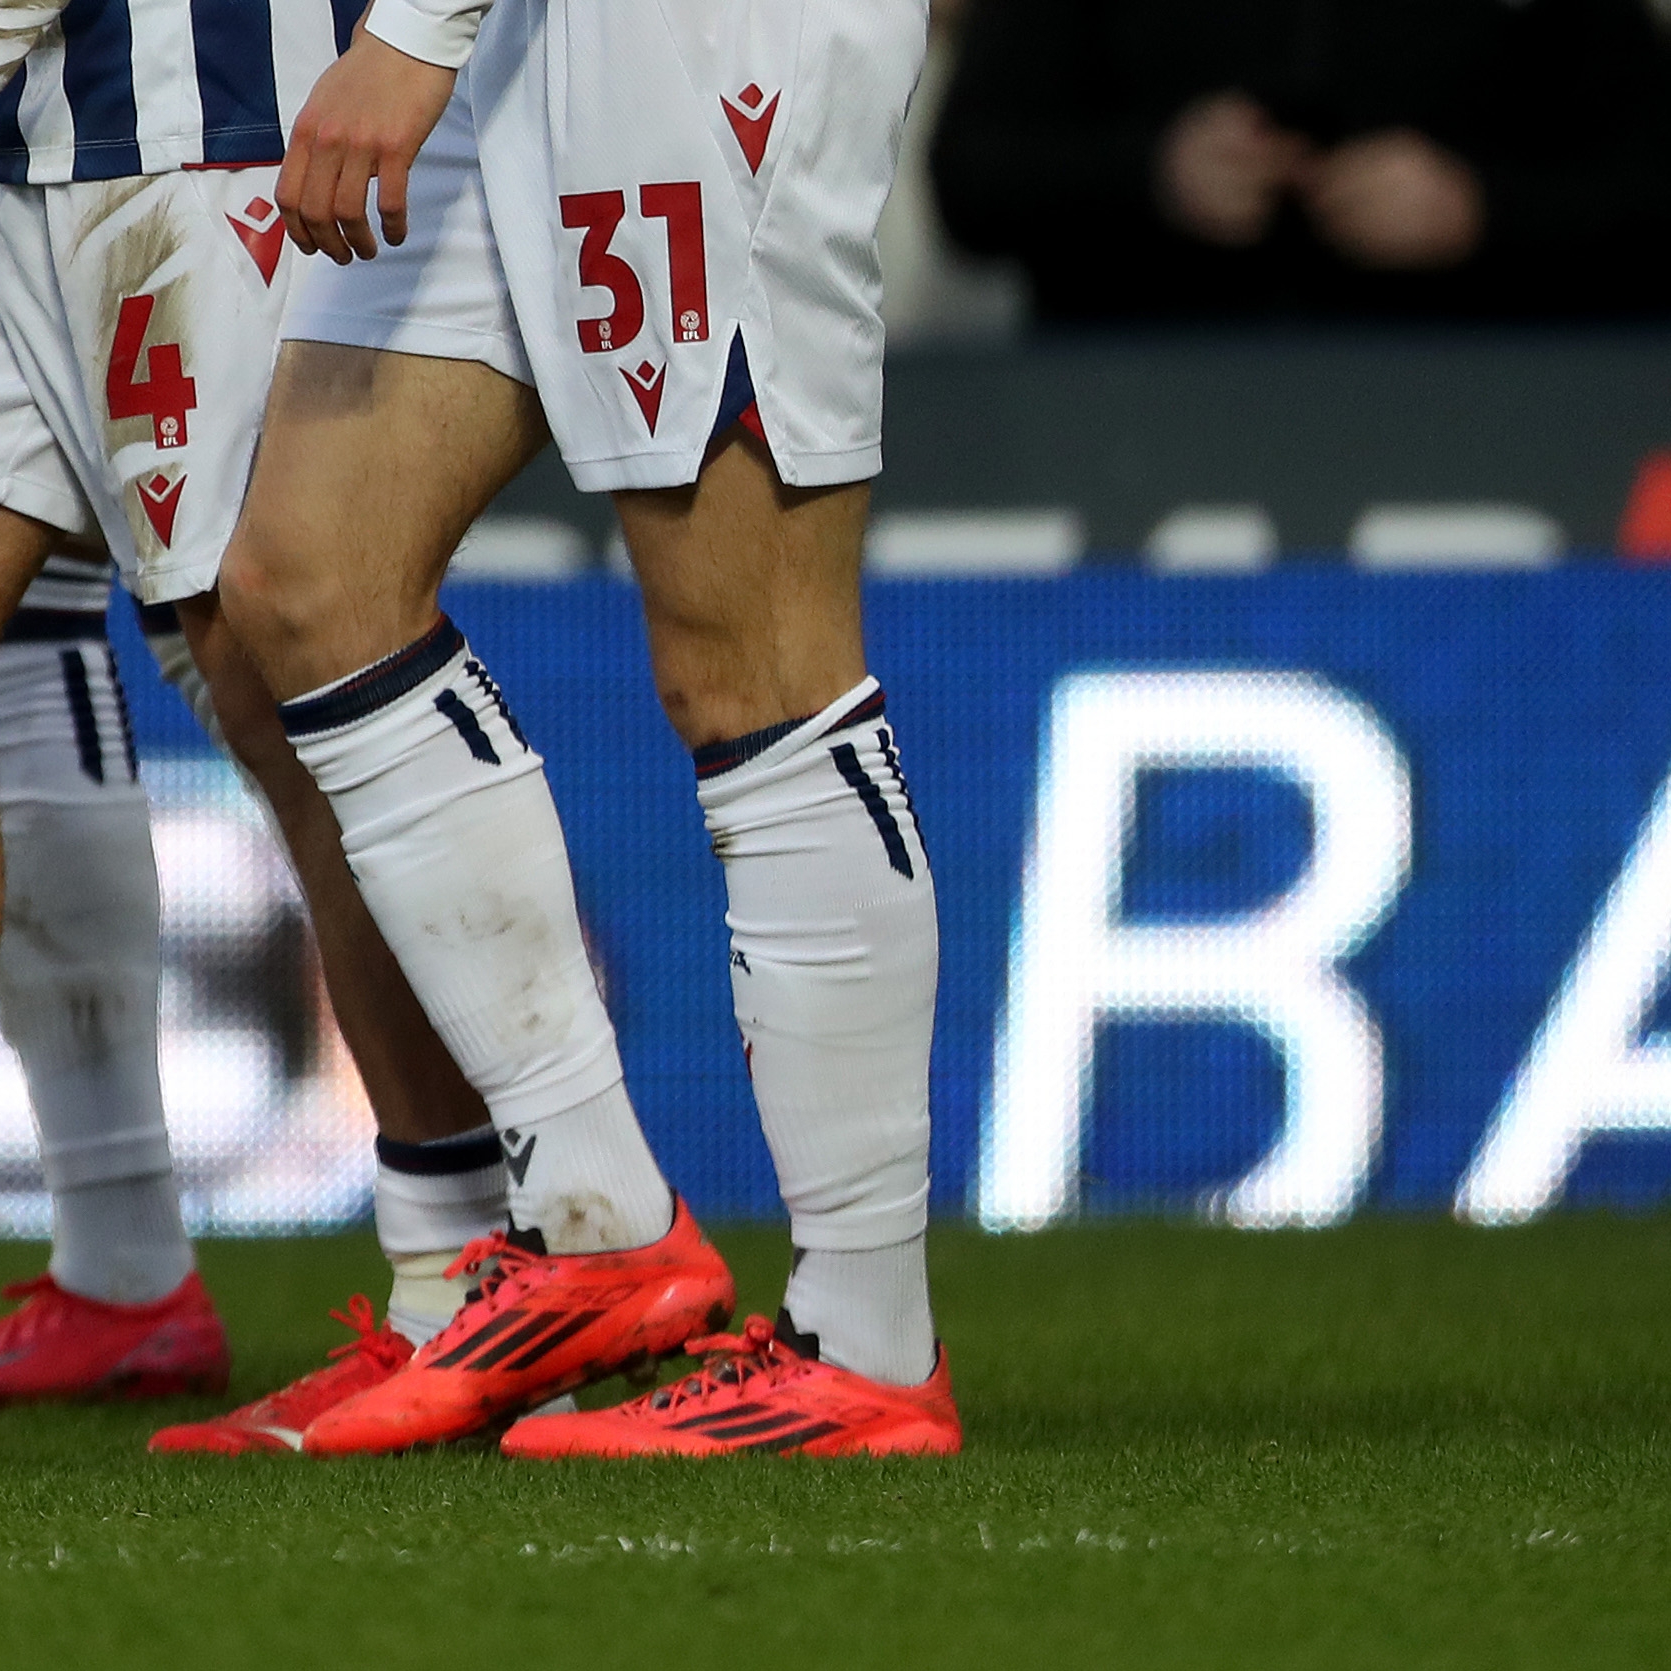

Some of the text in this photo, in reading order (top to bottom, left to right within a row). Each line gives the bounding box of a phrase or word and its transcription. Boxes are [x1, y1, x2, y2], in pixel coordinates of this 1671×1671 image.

[559, 181, 710, 354] 31
[107, 293, 198, 451] 4
[683, 330, 700, 341] EFL
[163, 437, 179, 447] EFL
